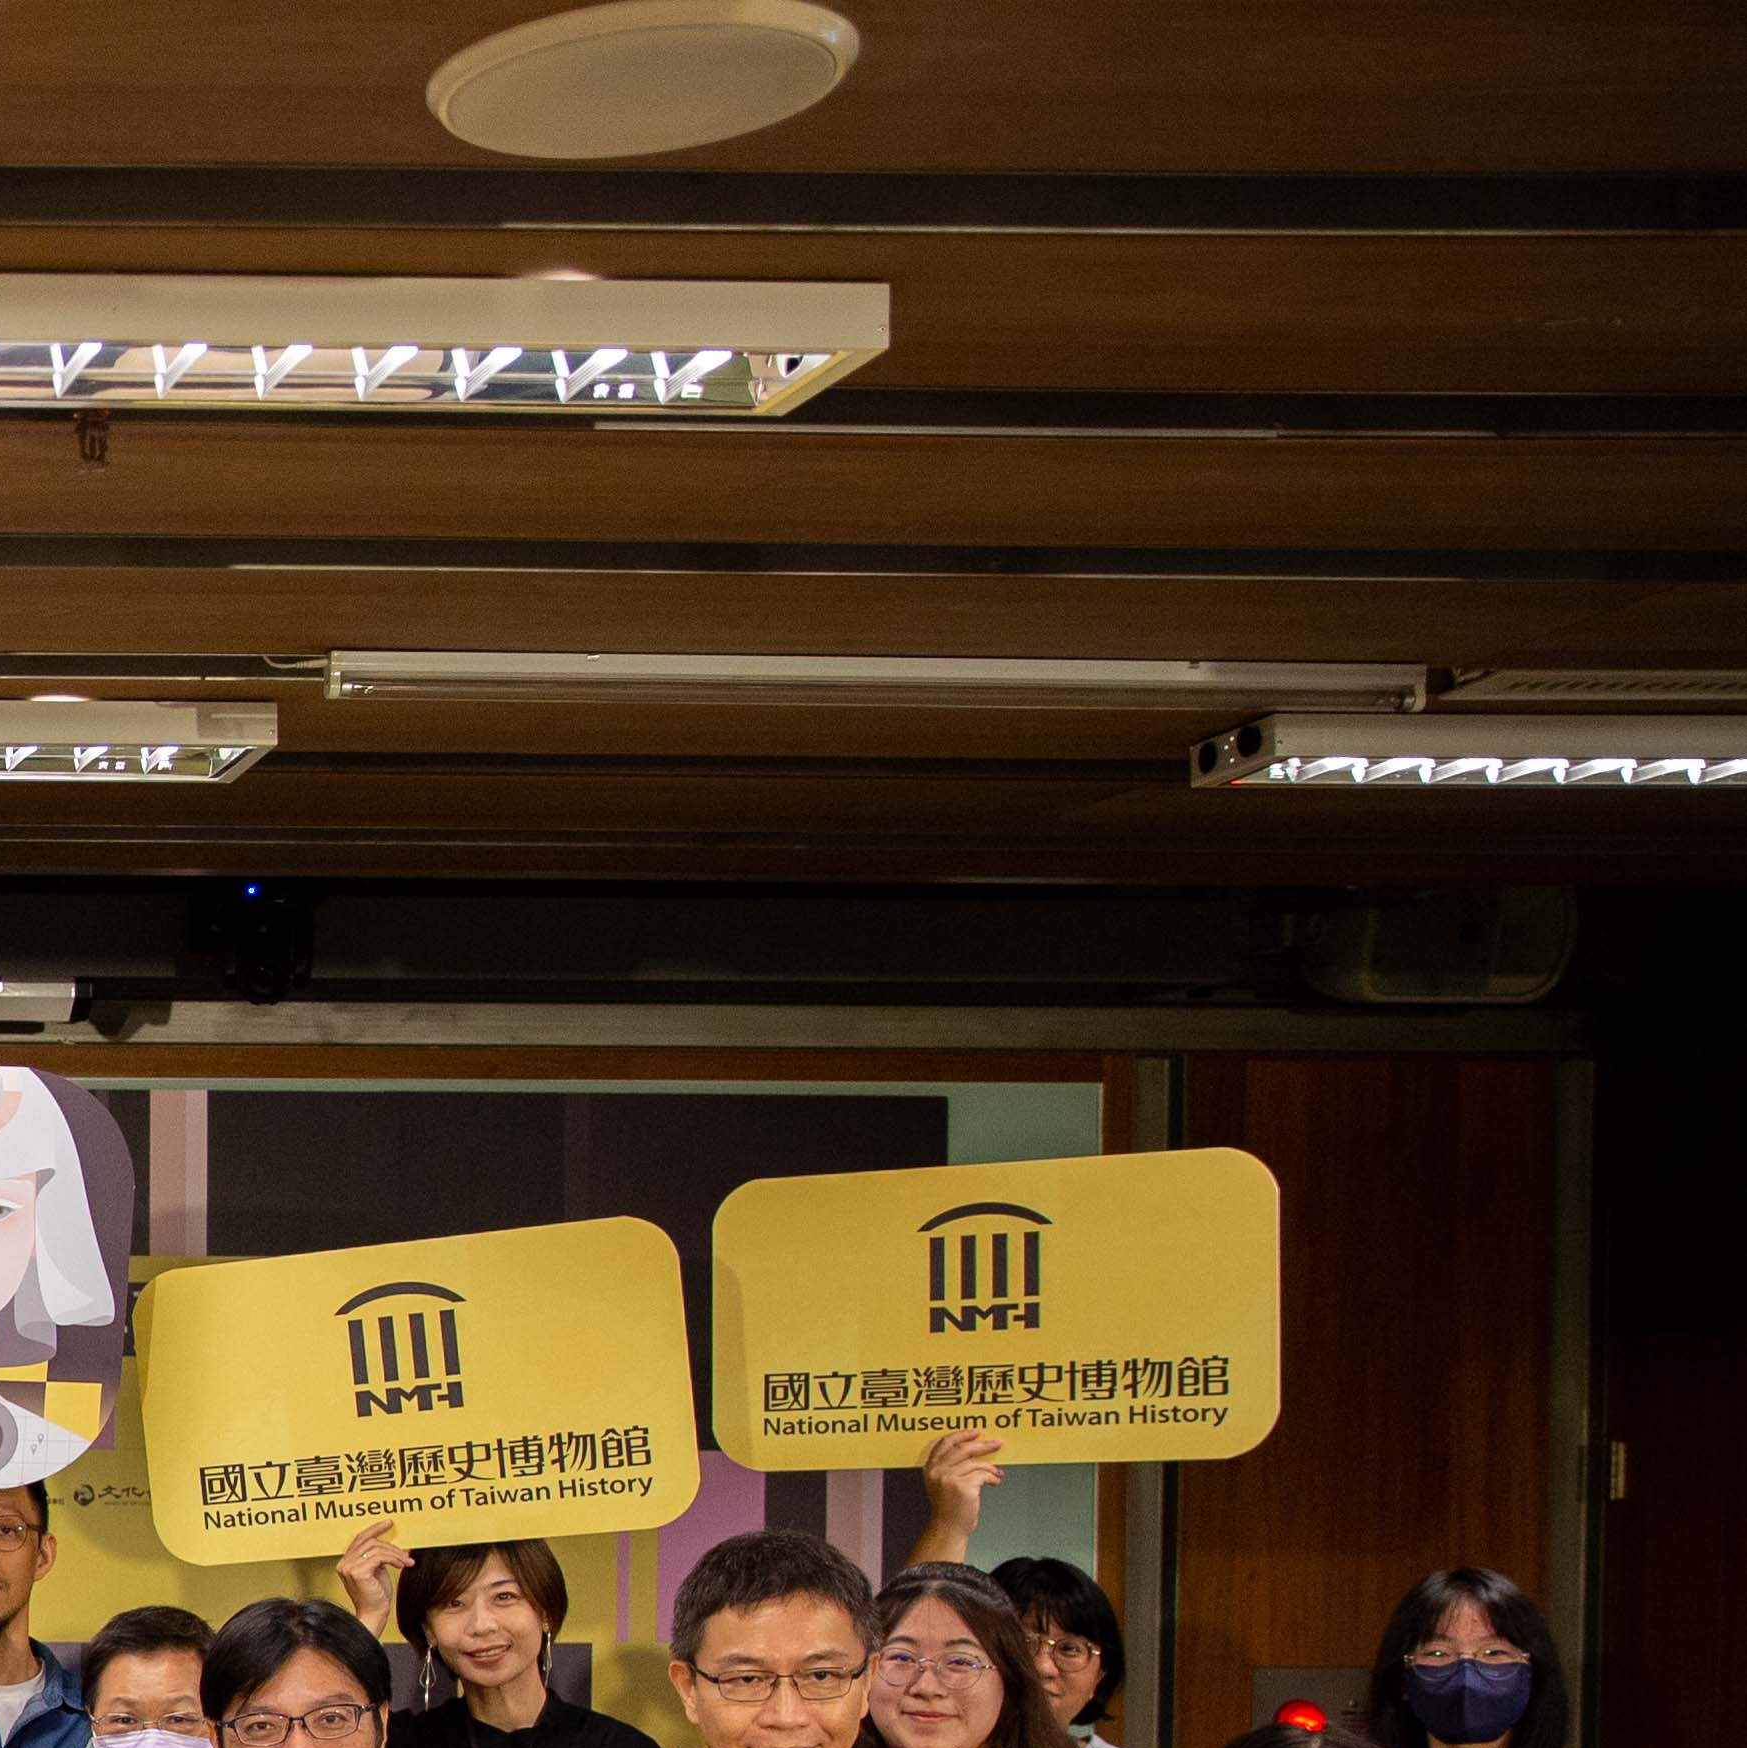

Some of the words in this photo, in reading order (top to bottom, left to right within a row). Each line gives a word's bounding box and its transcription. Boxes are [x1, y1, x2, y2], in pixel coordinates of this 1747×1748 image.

[763, 1355, 1229, 1412] 國立臺灣歷史博物館
[763, 1412, 869, 1436] National
[876, 1411, 987, 1432] Museum
[994, 1408, 1022, 1429] of
[1025, 1407, 1120, 1428] Taiwan
[1128, 1404, 1229, 1428] History
[98, 1485, 151, 1498] 文化
[199, 1425, 652, 1505] 國立臺灣歷史博物館
[203, 1501, 307, 1530] National
[315, 1496, 423, 1521] Museum
[429, 1487, 456, 1510] of
[459, 1483, 551, 1507] Taiwan
[558, 1474, 653, 1501] History
